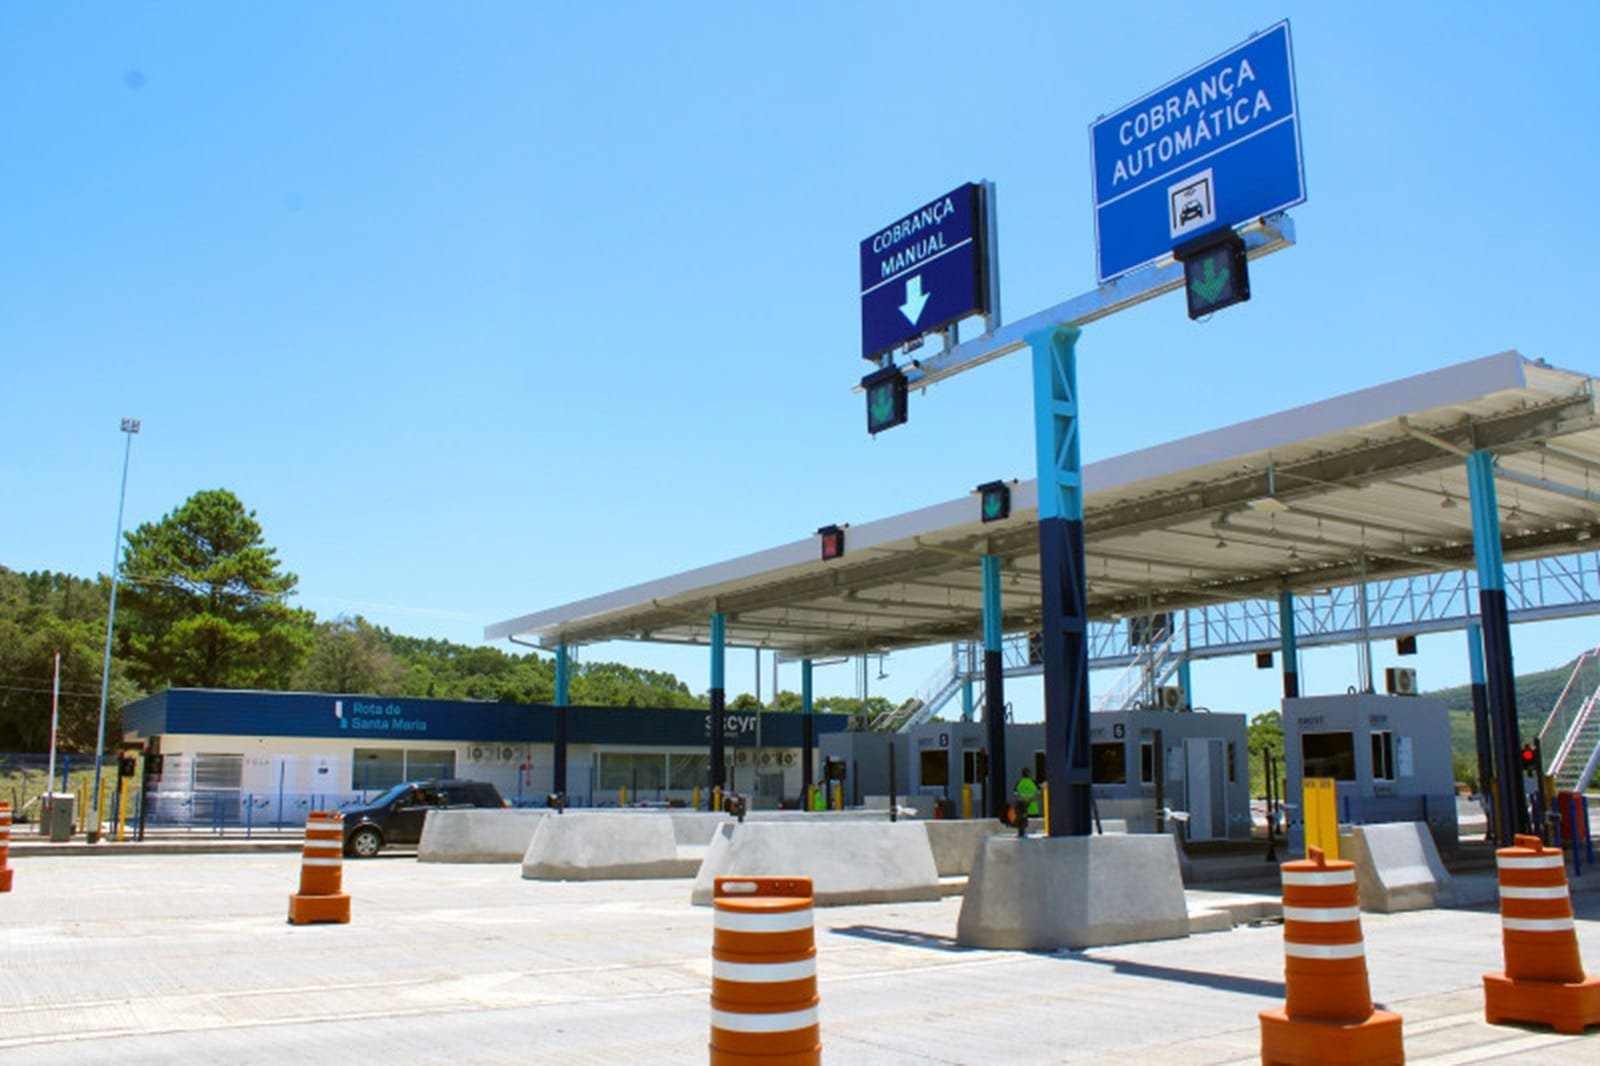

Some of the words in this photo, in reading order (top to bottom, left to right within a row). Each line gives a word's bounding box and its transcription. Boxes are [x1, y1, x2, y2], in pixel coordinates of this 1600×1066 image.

[1119, 58, 1256, 146] COBRANÇA
[1112, 89, 1272, 187] AUTOMÁTICA
[872, 197, 955, 254] COBRANÇA
[880, 231, 947, 278] MANUAL
[351, 717, 389, 730] Santa
[391, 718, 428, 731] Maria
[353, 702, 383, 715] Rota
[385, 703, 401, 715] de
[704, 715, 757, 733] Scyr
